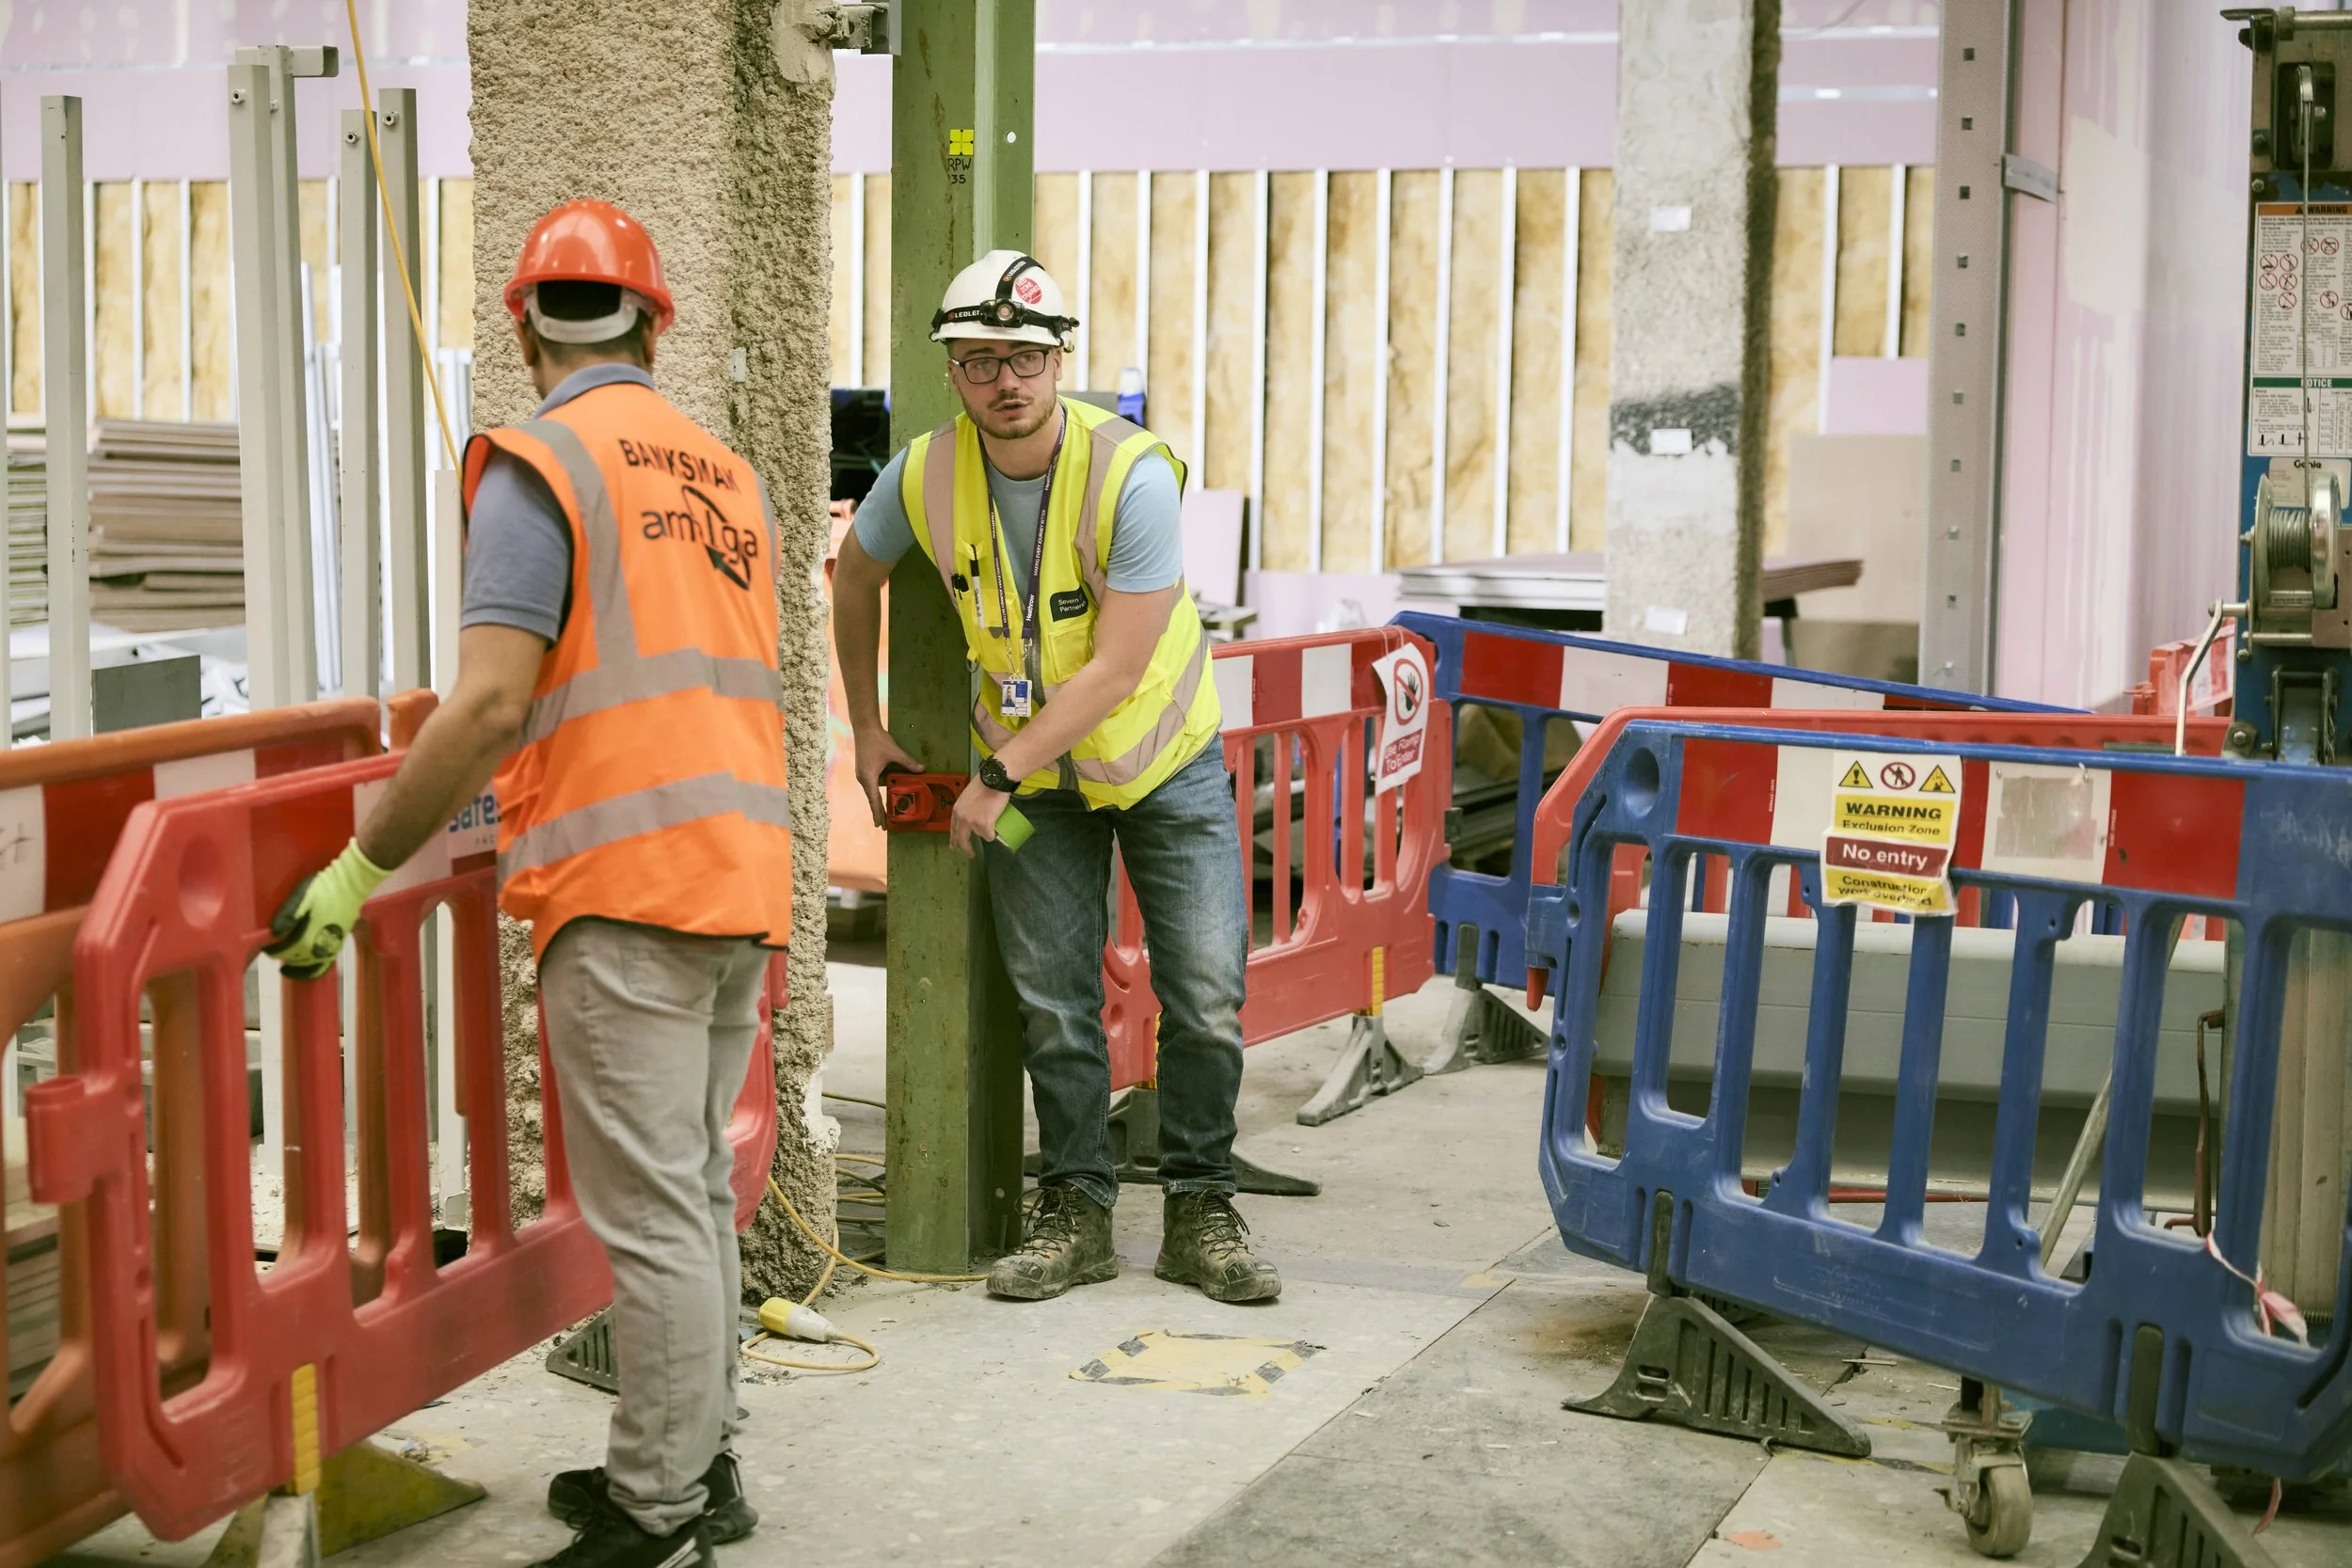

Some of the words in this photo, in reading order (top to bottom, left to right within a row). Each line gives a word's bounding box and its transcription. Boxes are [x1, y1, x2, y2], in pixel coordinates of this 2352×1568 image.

[947, 158, 972, 171] RPW
[950, 174, 966, 184] 35
[2308, 205, 2347, 215] WARNING
[1021, 280, 1034, 293] ZONE
[1022, 284, 1040, 301] TRAINED
[618, 438, 742, 495] BANKSMAN
[1058, 597, 1079, 606] Severn
[1386, 757, 1397, 771] To
[449, 795, 501, 833] safe
[1846, 801, 1942, 820] WARNING
[1842, 819, 1904, 833] Exclusion
[1908, 824, 1940, 835] Zone
[1842, 843, 1870, 861] No
[1876, 850, 1928, 871] entry
[1873, 891, 1932, 906] overhd
